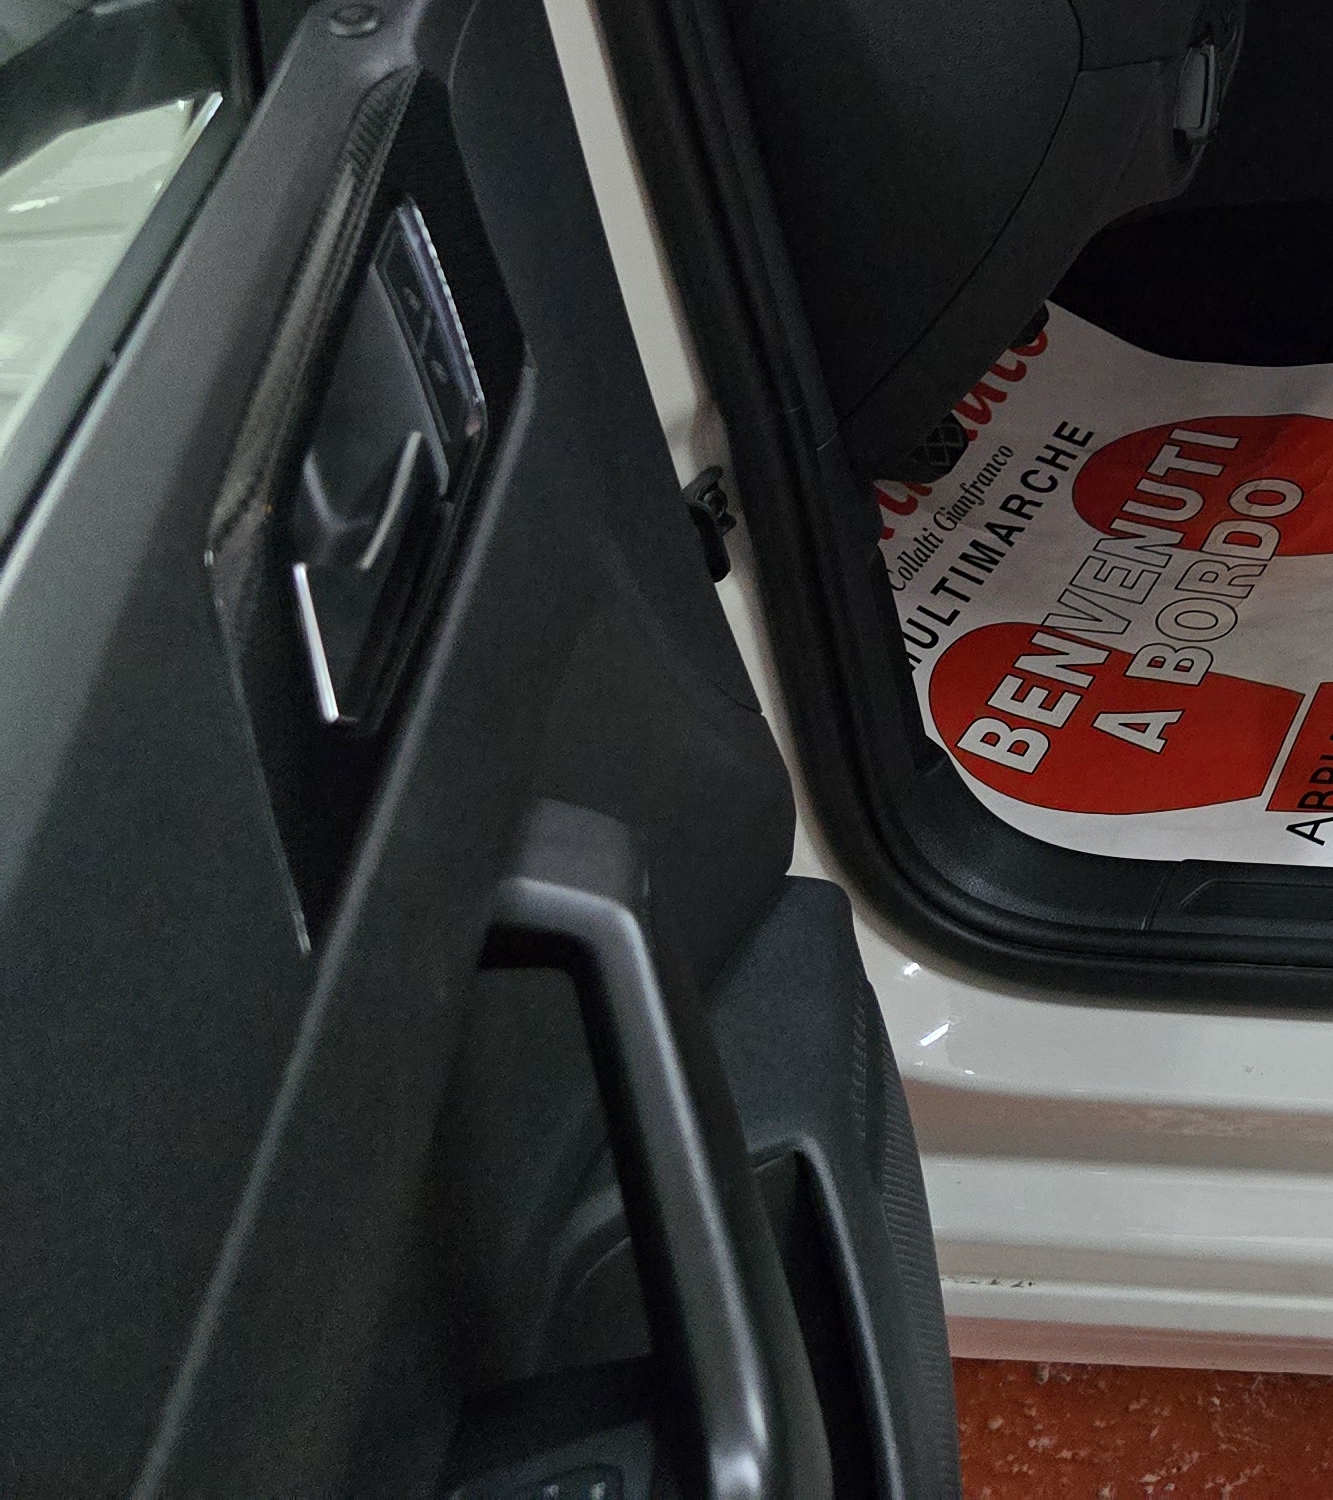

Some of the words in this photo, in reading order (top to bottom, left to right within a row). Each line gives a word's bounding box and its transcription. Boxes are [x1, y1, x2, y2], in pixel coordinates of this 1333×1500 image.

[889, 526, 944, 592] Collalti
[933, 444, 1015, 535] Gianfranco
[956, 428, 1241, 775] BENVENUTI
[1123, 477, 1305, 687] BORDO
[1091, 708, 1186, 755] A
